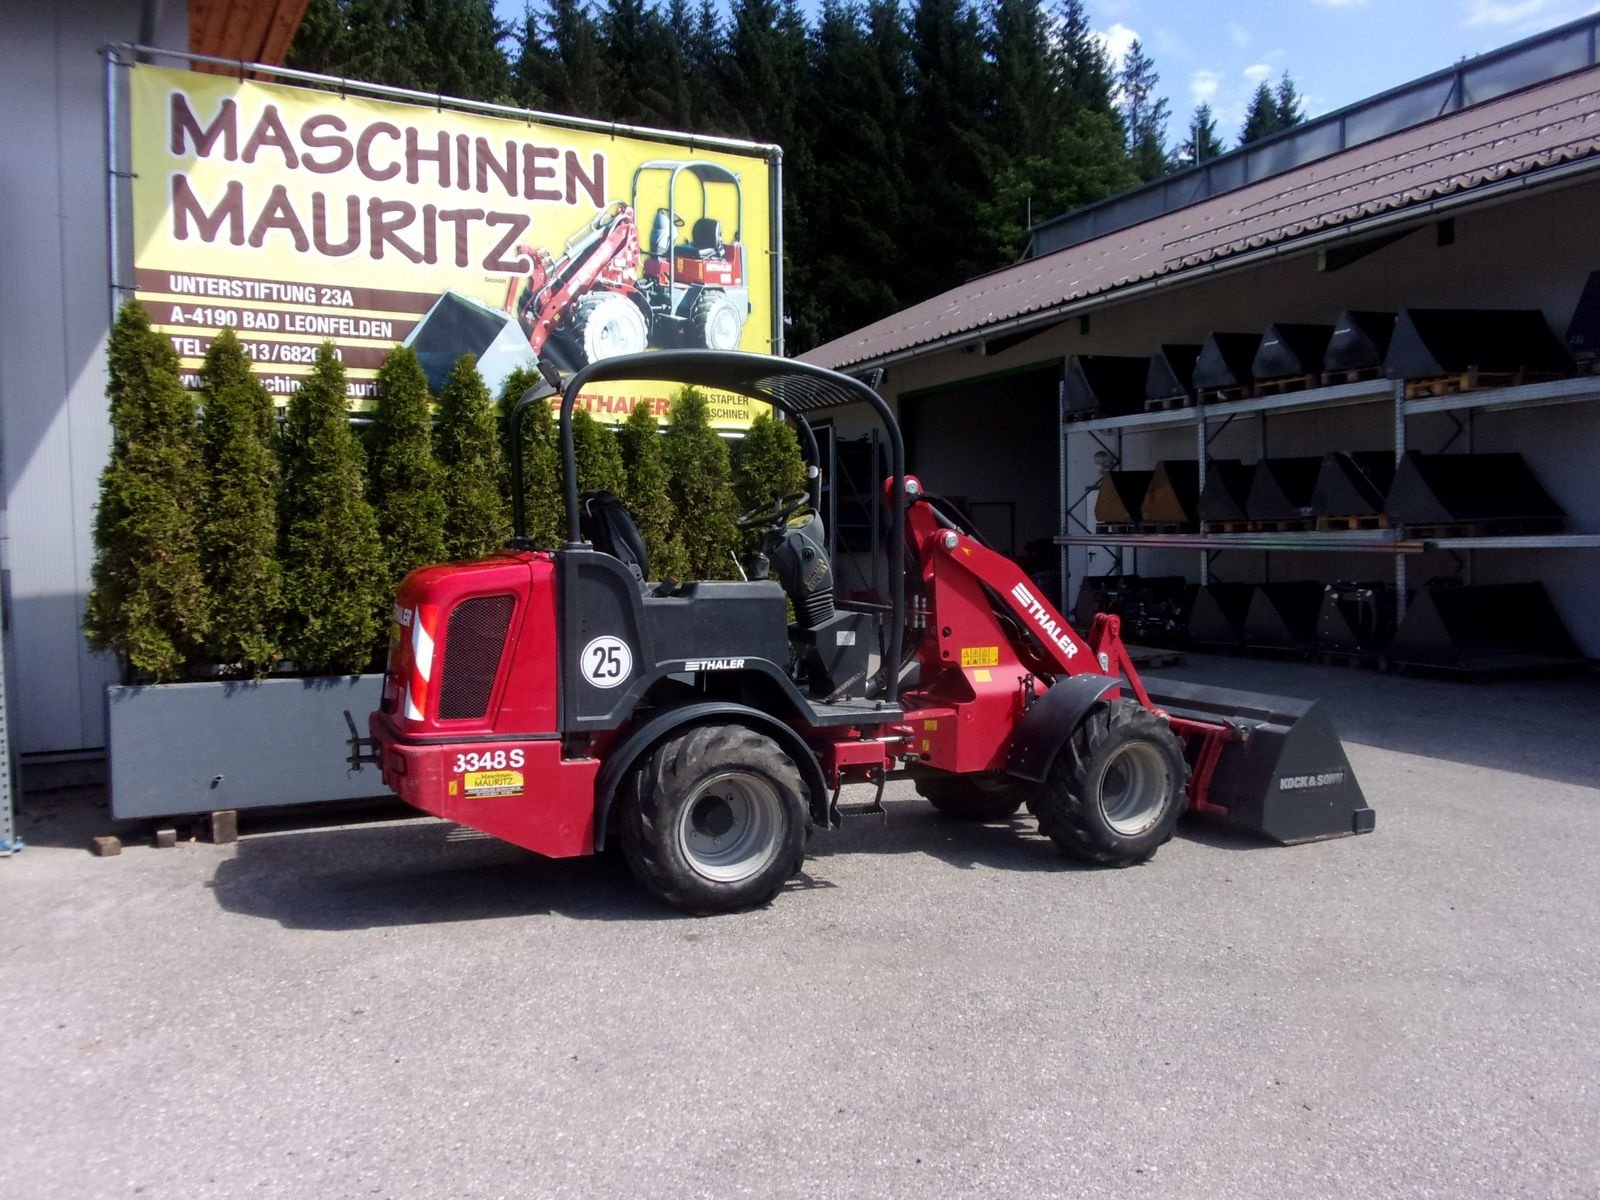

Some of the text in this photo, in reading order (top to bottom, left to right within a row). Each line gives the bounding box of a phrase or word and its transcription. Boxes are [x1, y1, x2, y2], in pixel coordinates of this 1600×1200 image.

[170, 92, 605, 209] MASCHINEN
[171, 173, 531, 274] MAURITZ
[169, 274, 354, 307] UNTERSTIFTUNG 23A
[170, 305, 393, 338] A-4190 BAD LEONFELDEN
[592, 646, 621, 679] 25
[453, 748, 525, 773] 3348 S
[474, 777, 513, 787] MAURITZ
[1308, 776, 1316, 787] &
